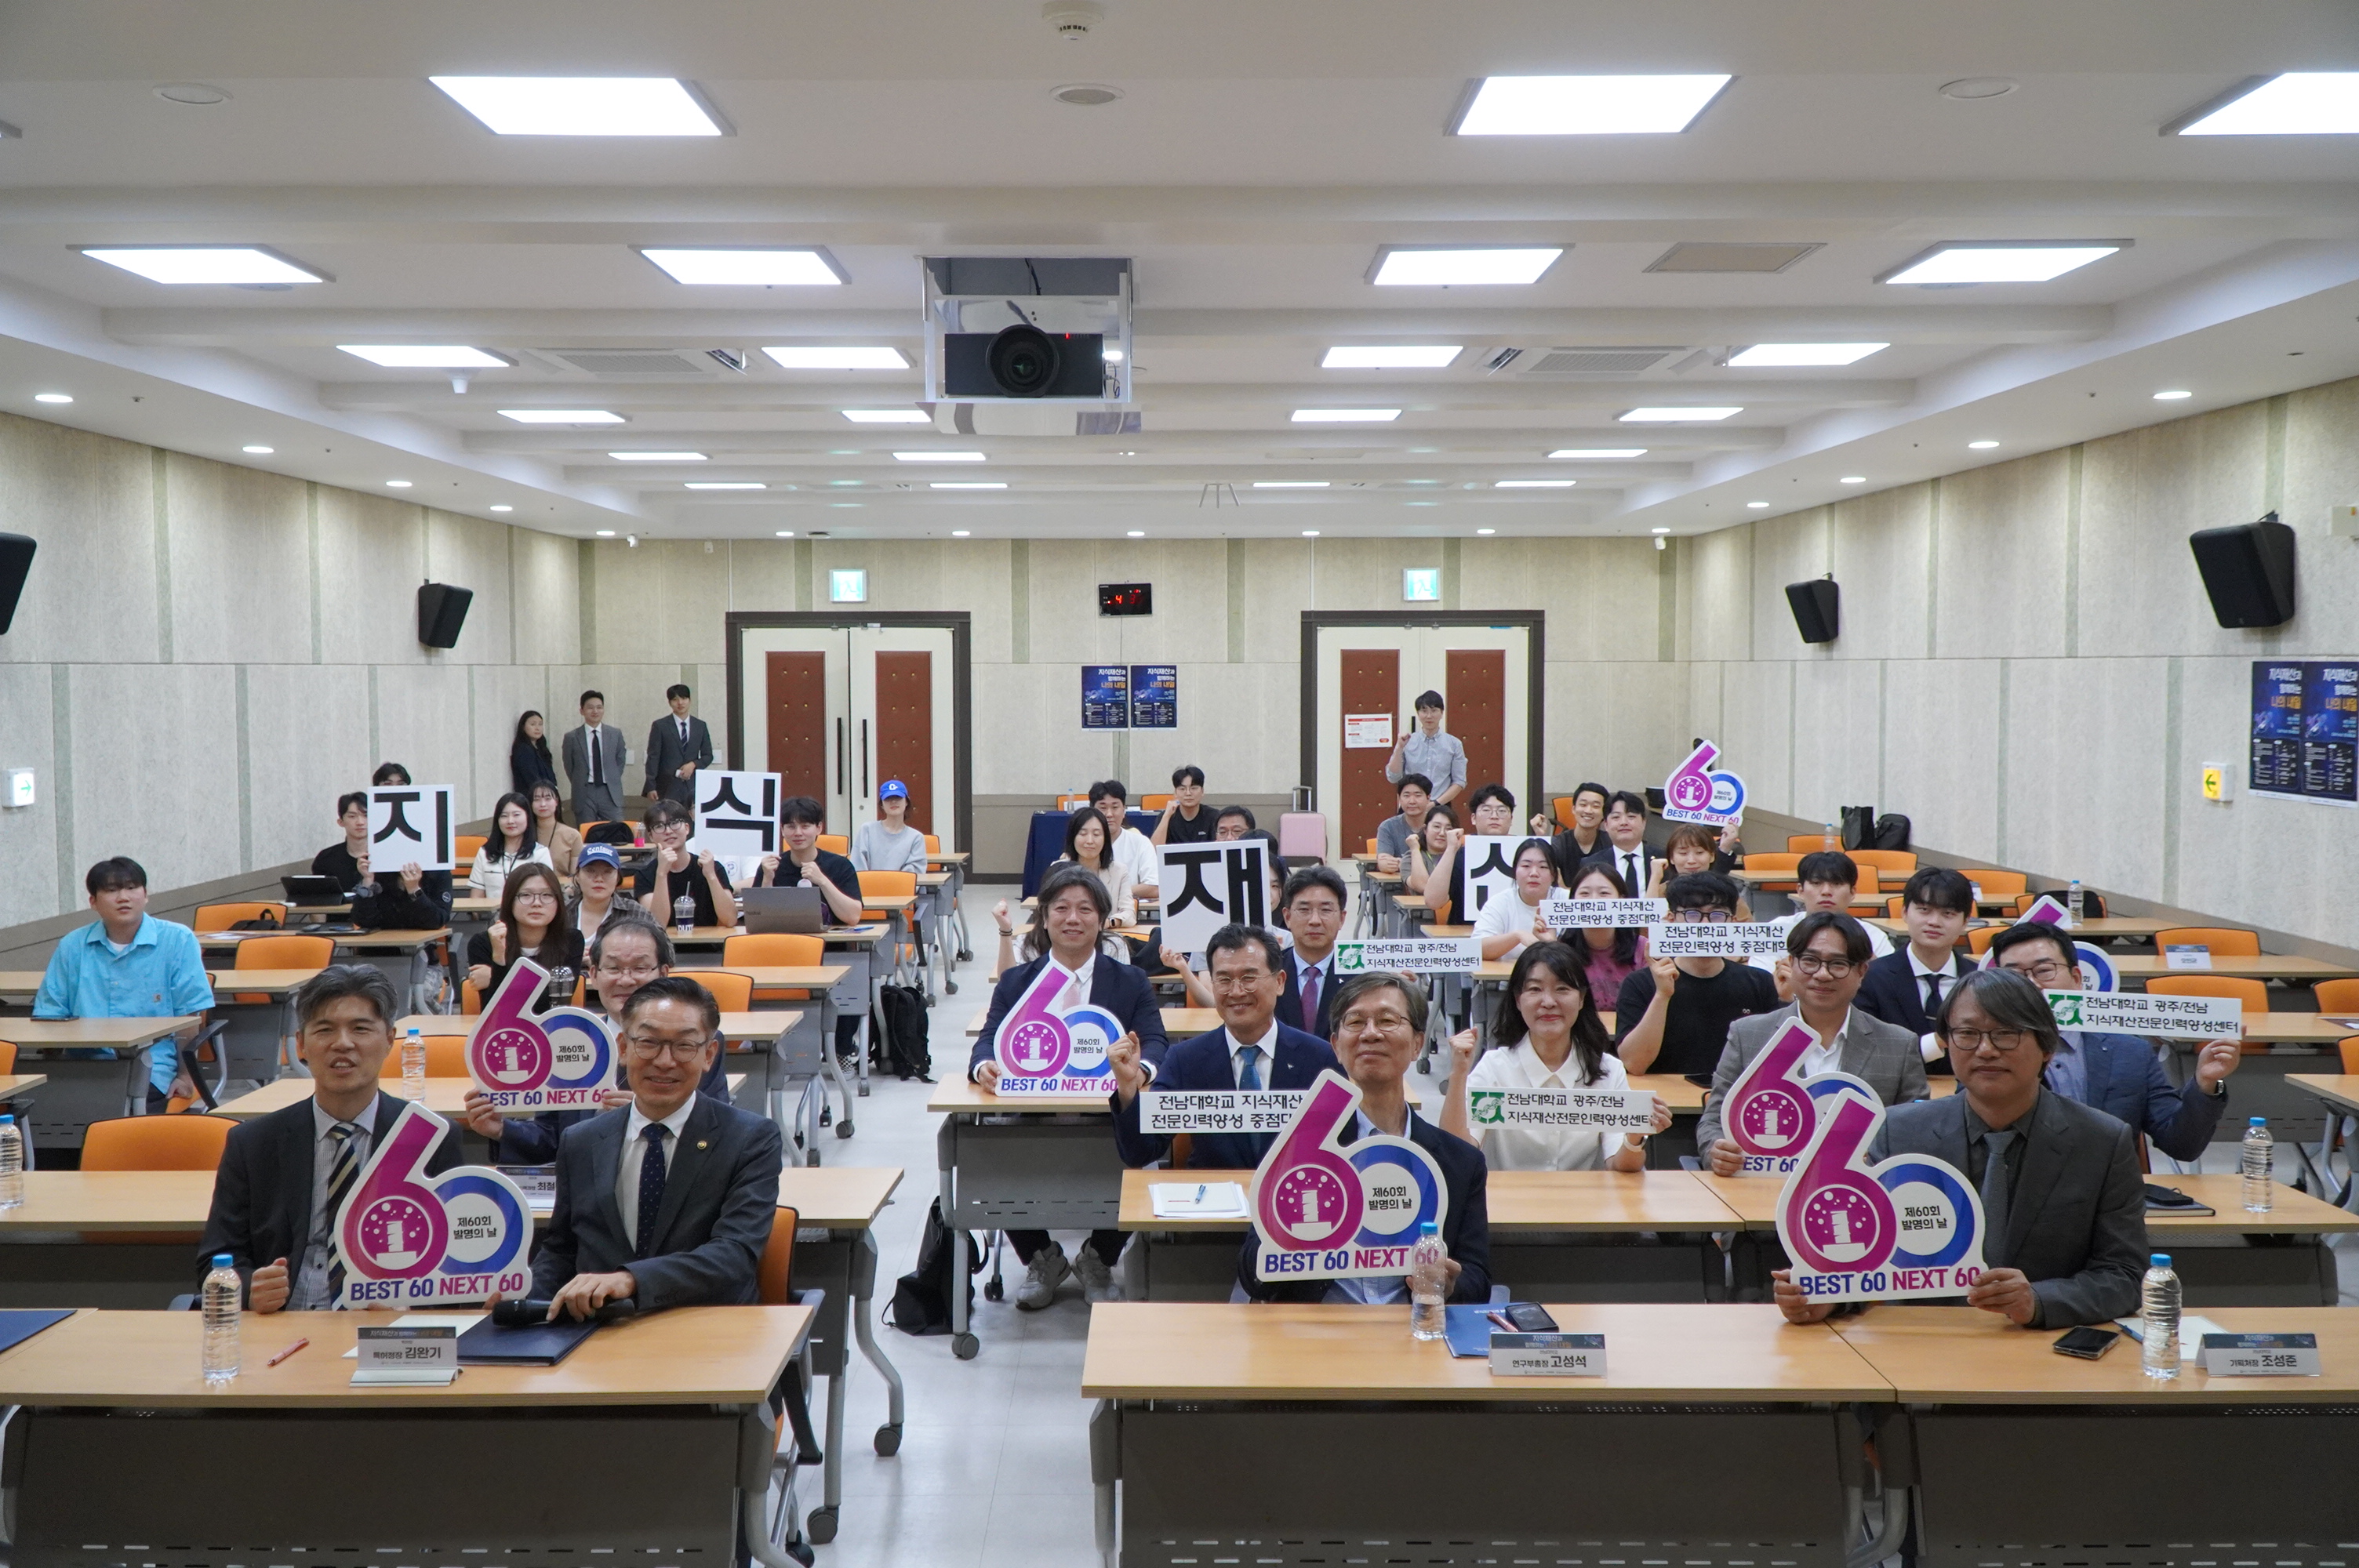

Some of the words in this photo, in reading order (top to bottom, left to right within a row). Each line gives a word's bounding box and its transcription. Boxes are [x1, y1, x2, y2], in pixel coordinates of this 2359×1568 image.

[700, 777, 775, 851] 식
[1667, 809, 1689, 818] BEST
[1703, 814, 1727, 823] NEXT
[373, 791, 449, 863] 지
[1164, 848, 1265, 929] 재
[1554, 902, 1606, 913] 전남대학교
[1612, 902, 1654, 912] 지식재산
[1548, 914, 1612, 925] 전문인력양성
[1617, 914, 1660, 924] 중점대학
[1665, 926, 1728, 938] 전남대학교
[1733, 926, 1783, 938] 지식재산
[1366, 944, 1412, 954] 전남대학교
[1418, 943, 1457, 953] 광주/전남
[1659, 941, 1735, 953] 전문인력양성
[1367, 956, 1480, 968] 지식재산전문인력양성센터
[2086, 996, 2148, 1011] 전남대학교
[2154, 1000, 2208, 1014] 광주/전남
[2086, 1014, 2238, 1033] 지식재산전문인력양성센터
[1001, 1079, 1038, 1091] BEST
[1041, 1079, 1057, 1091] 60
[1061, 1079, 1098, 1091] NEXT
[1101, 1079, 1118, 1091] 60
[523, 1091, 542, 1105] 60
[547, 1090, 589, 1105] NEXT
[1159, 1095, 1234, 1110] 전남대학교
[1241, 1094, 1303, 1109] 지식재산
[1507, 1093, 1567, 1106] 전남대학교
[1573, 1095, 1624, 1108] 광주/전남
[1151, 1113, 1243, 1129] 전문인력양성
[1743, 1156, 1776, 1172] EST
[1372, 1186, 1406, 1197] 제60회
[1369, 1199, 1399, 1210] 발명의
[1402, 1198, 1412, 1209] 날
[1904, 1206, 1940, 1218] 제60회
[457, 1216, 491, 1227] 제60회
[1902, 1220, 1934, 1231] 발명의
[1937, 1218, 1947, 1229] 날
[453, 1228, 484, 1240] 발명의
[487, 1227, 497, 1238] 날
[1265, 1252, 1319, 1273] BEST
[1324, 1250, 1349, 1270] 60
[1354, 1247, 1409, 1269] NEXT
[351, 1280, 404, 1301] BEST
[409, 1279, 433, 1298] 60
[439, 1275, 493, 1296] NEXT
[498, 1273, 523, 1292] 60
[1799, 1274, 1854, 1295] BEST
[1860, 1272, 1885, 1293] 60
[1892, 1269, 1948, 1290] NEXT
[1955, 1266, 1980, 1287] 60
[405, 1347, 441, 1359] 김완기
[1550, 1356, 1587, 1367] 고성석
[2262, 1355, 2297, 1367] 조성준
